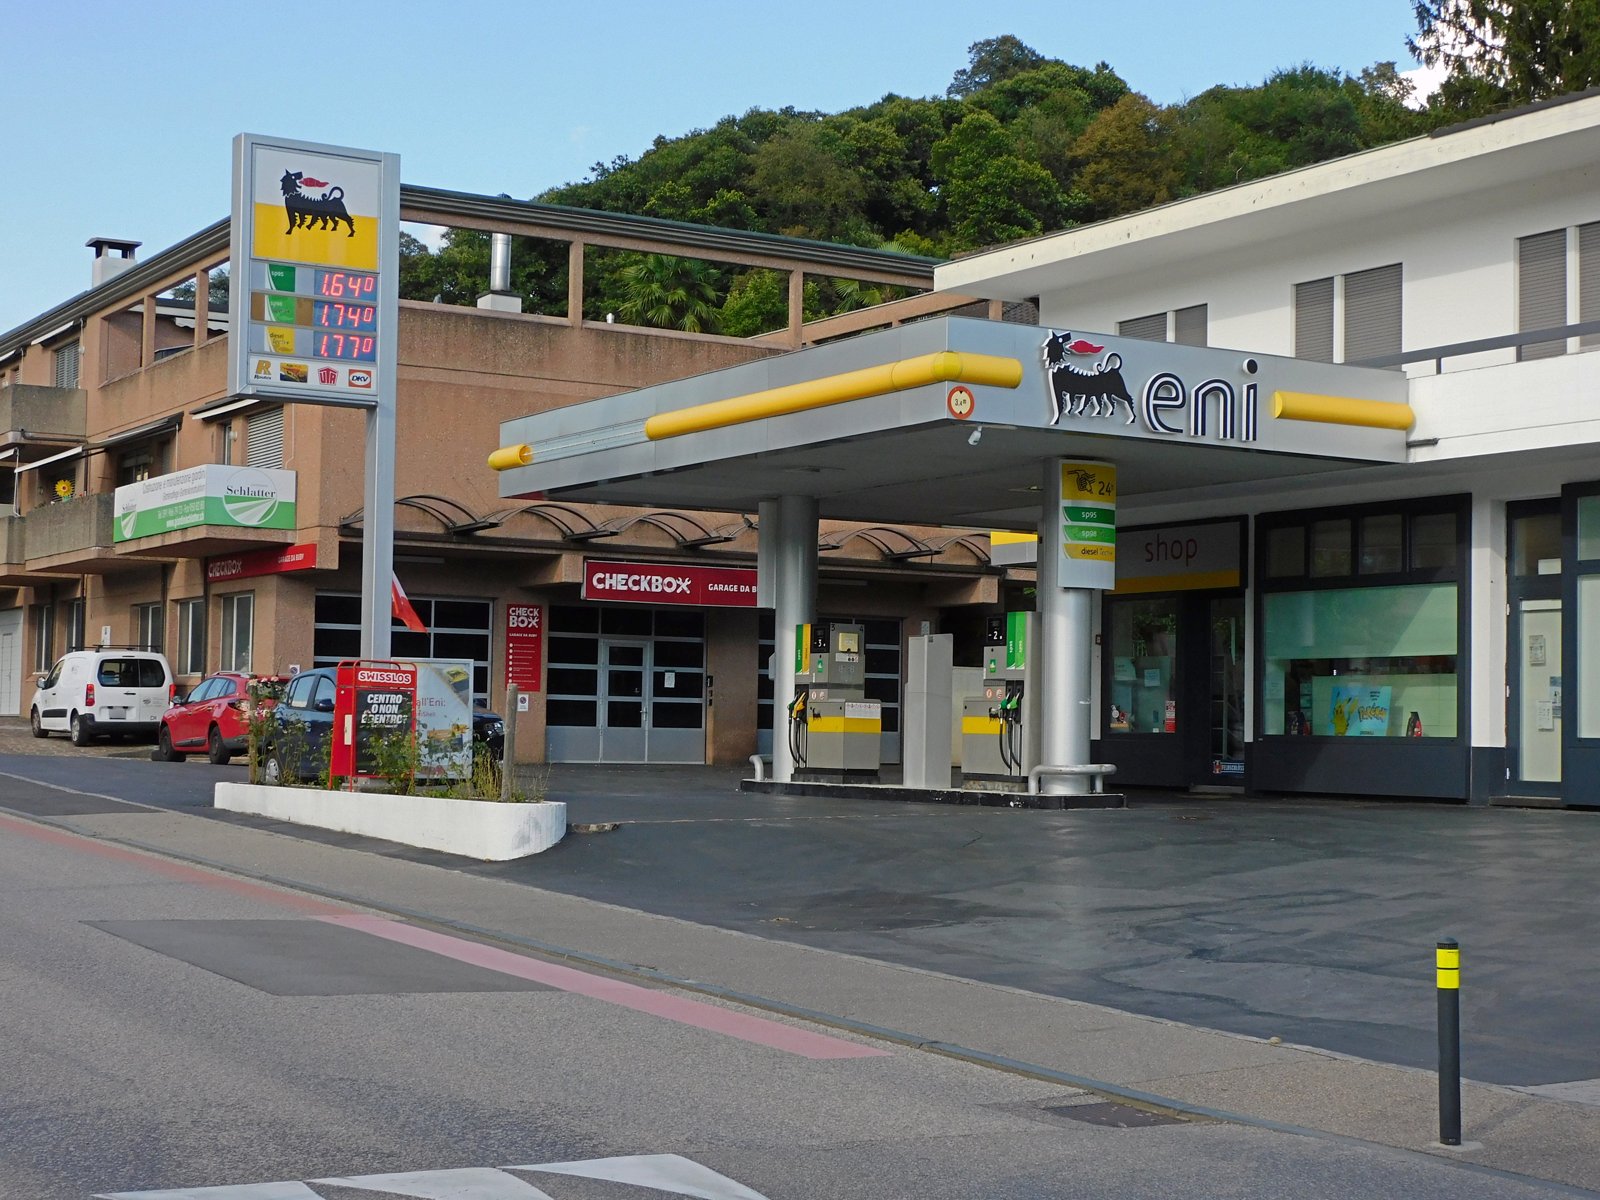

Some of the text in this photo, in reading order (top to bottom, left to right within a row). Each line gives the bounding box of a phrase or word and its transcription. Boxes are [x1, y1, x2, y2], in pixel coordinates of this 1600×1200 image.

[351, 374, 369, 383] DKV
[1142, 357, 1260, 442] eni
[226, 485, 277, 498] Schlatter
[1081, 511, 1098, 519] sp95
[1080, 547, 1099, 556] diesel
[1144, 534, 1198, 567] shop
[208, 559, 242, 578] CHECKBOX
[592, 572, 692, 595] CHECKBOX
[708, 583, 738, 593] GARAGE
[740, 584, 750, 593] DA
[509, 607, 540, 617] CHECK
[509, 615, 540, 629] BOX
[359, 671, 411, 684] SWISSLOS
[367, 693, 403, 704] CENTRO
[371, 704, 399, 714] O NON
